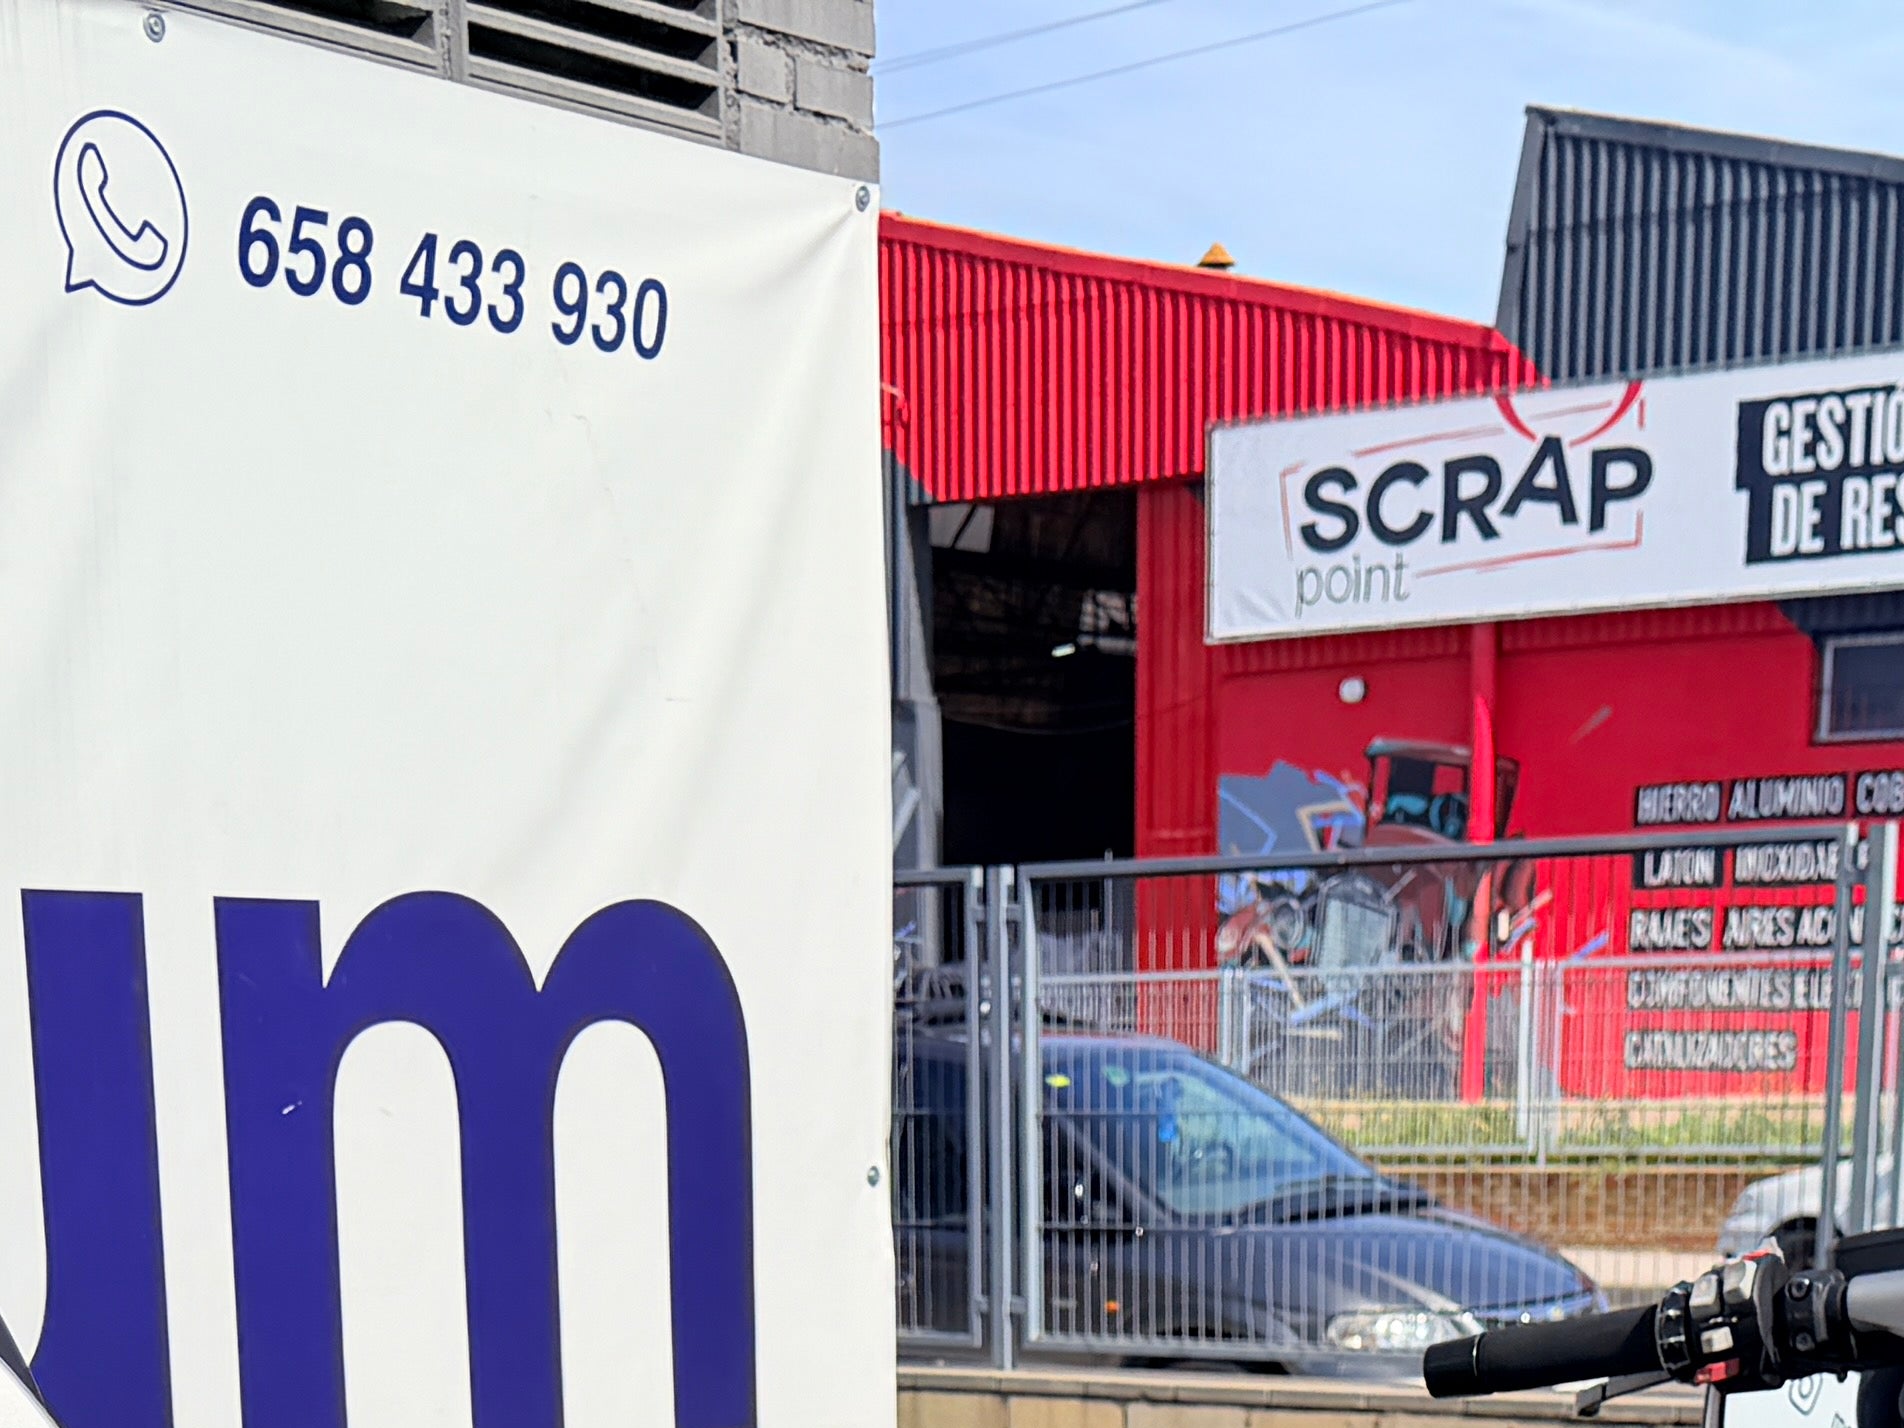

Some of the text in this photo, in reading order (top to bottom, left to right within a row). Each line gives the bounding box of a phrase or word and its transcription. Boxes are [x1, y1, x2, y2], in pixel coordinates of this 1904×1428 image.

[237, 195, 669, 361] 658 433 930
[1298, 435, 1654, 555] SCRAP
[1769, 479, 1828, 558] DE
[1295, 553, 1412, 619] point
[1636, 781, 1722, 825] HIERRO
[1726, 774, 1846, 821] ALUMINIO
